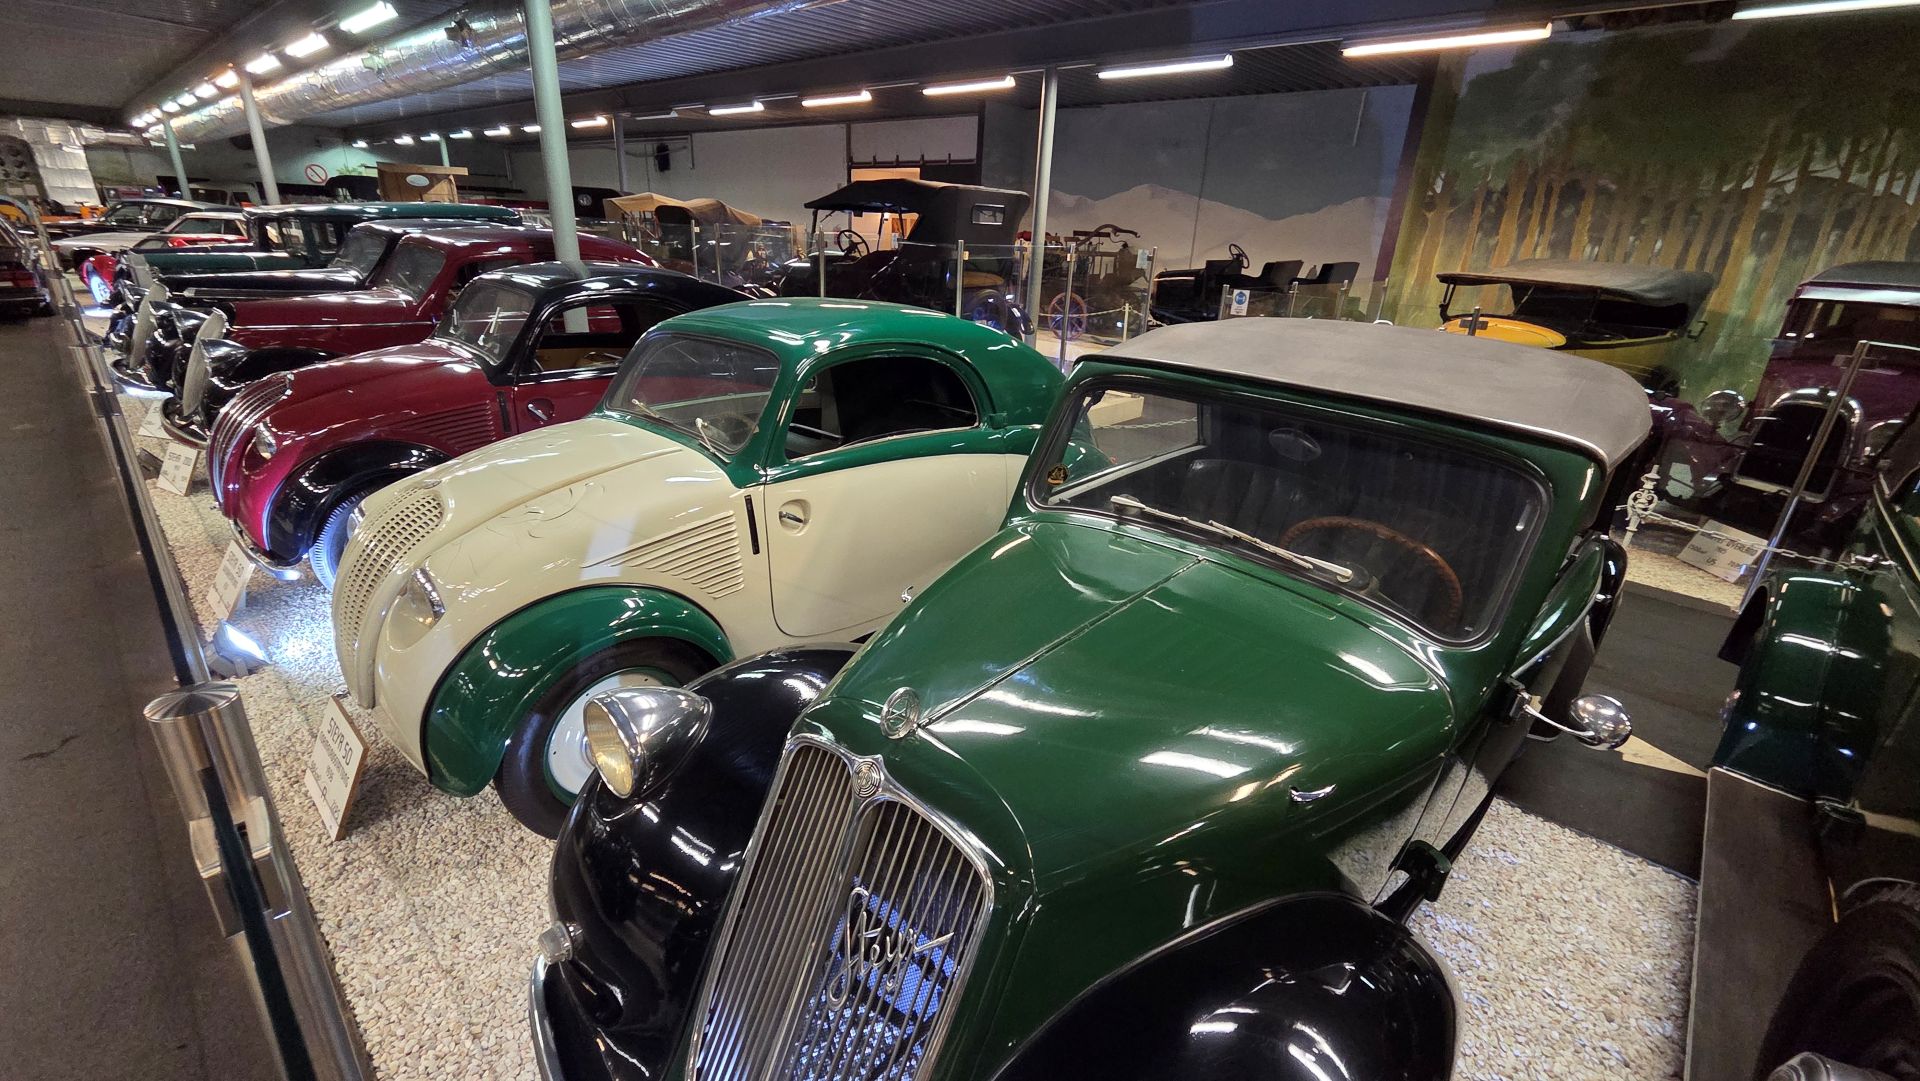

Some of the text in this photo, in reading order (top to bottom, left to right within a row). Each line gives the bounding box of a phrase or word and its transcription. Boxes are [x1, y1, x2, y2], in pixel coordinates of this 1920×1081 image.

[1706, 556, 1717, 567] US
[327, 717, 346, 753] STEYR
[341, 739, 353, 766] 50
[828, 886, 956, 1011] Steyr
